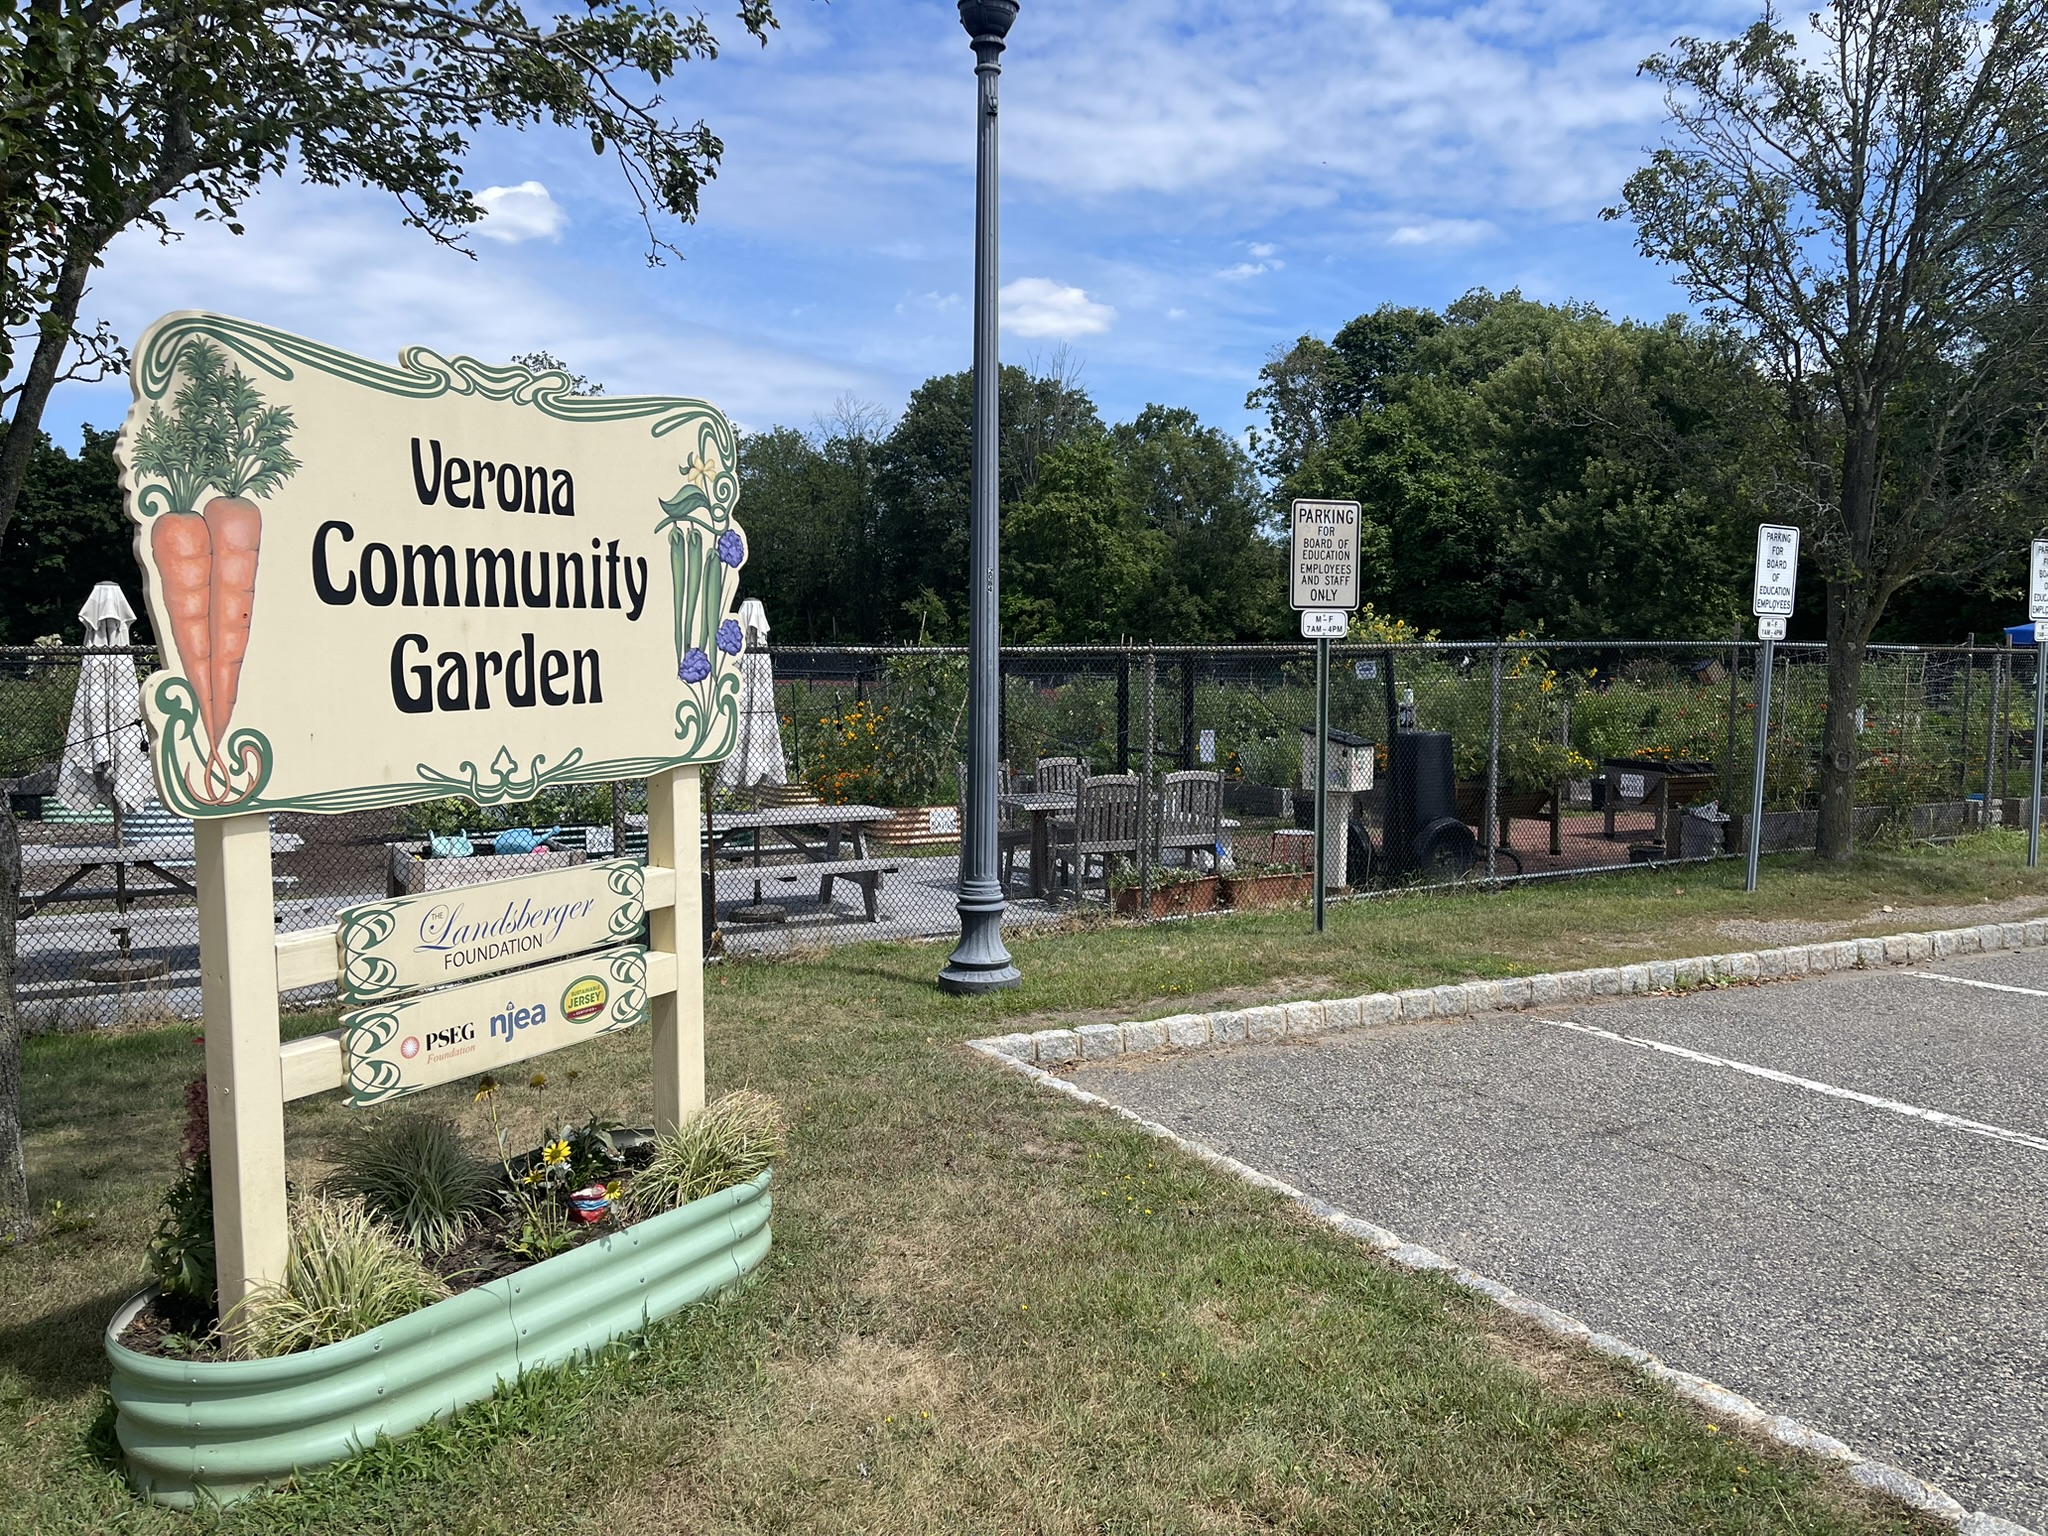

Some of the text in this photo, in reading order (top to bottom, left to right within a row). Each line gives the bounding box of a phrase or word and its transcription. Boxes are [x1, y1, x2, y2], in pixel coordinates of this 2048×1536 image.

[411, 437, 575, 516] Verona
[1299, 508, 1354, 524] PARKING
[1317, 526, 1335, 537] FOR
[1766, 532, 1792, 543] PARKING
[1303, 538, 1350, 549] BOARD OF
[1302, 550, 1350, 560] EDUCATION
[1771, 546, 1784, 556] FOR
[1300, 563, 1351, 575] EMPLOYEES
[1766, 559, 1787, 569] BOARD
[312, 520, 647, 621] Community
[1301, 575, 1351, 586] AND STAFF
[1771, 573, 1780, 583] OF
[1310, 589, 1338, 601] ONLY
[1759, 585, 1791, 596] EDUCATION
[1757, 598, 1791, 611] EMPLOYEES
[390, 633, 603, 713] Garden
[431, 912, 444, 921] THE
[413, 898, 596, 953] Landsberger
[444, 933, 543, 970] FOUNDATION
[568, 991, 602, 1009] JERSEY
[490, 1001, 546, 1042] njea
[426, 1022, 475, 1051] PSEG
[426, 1043, 476, 1065] Foundation
